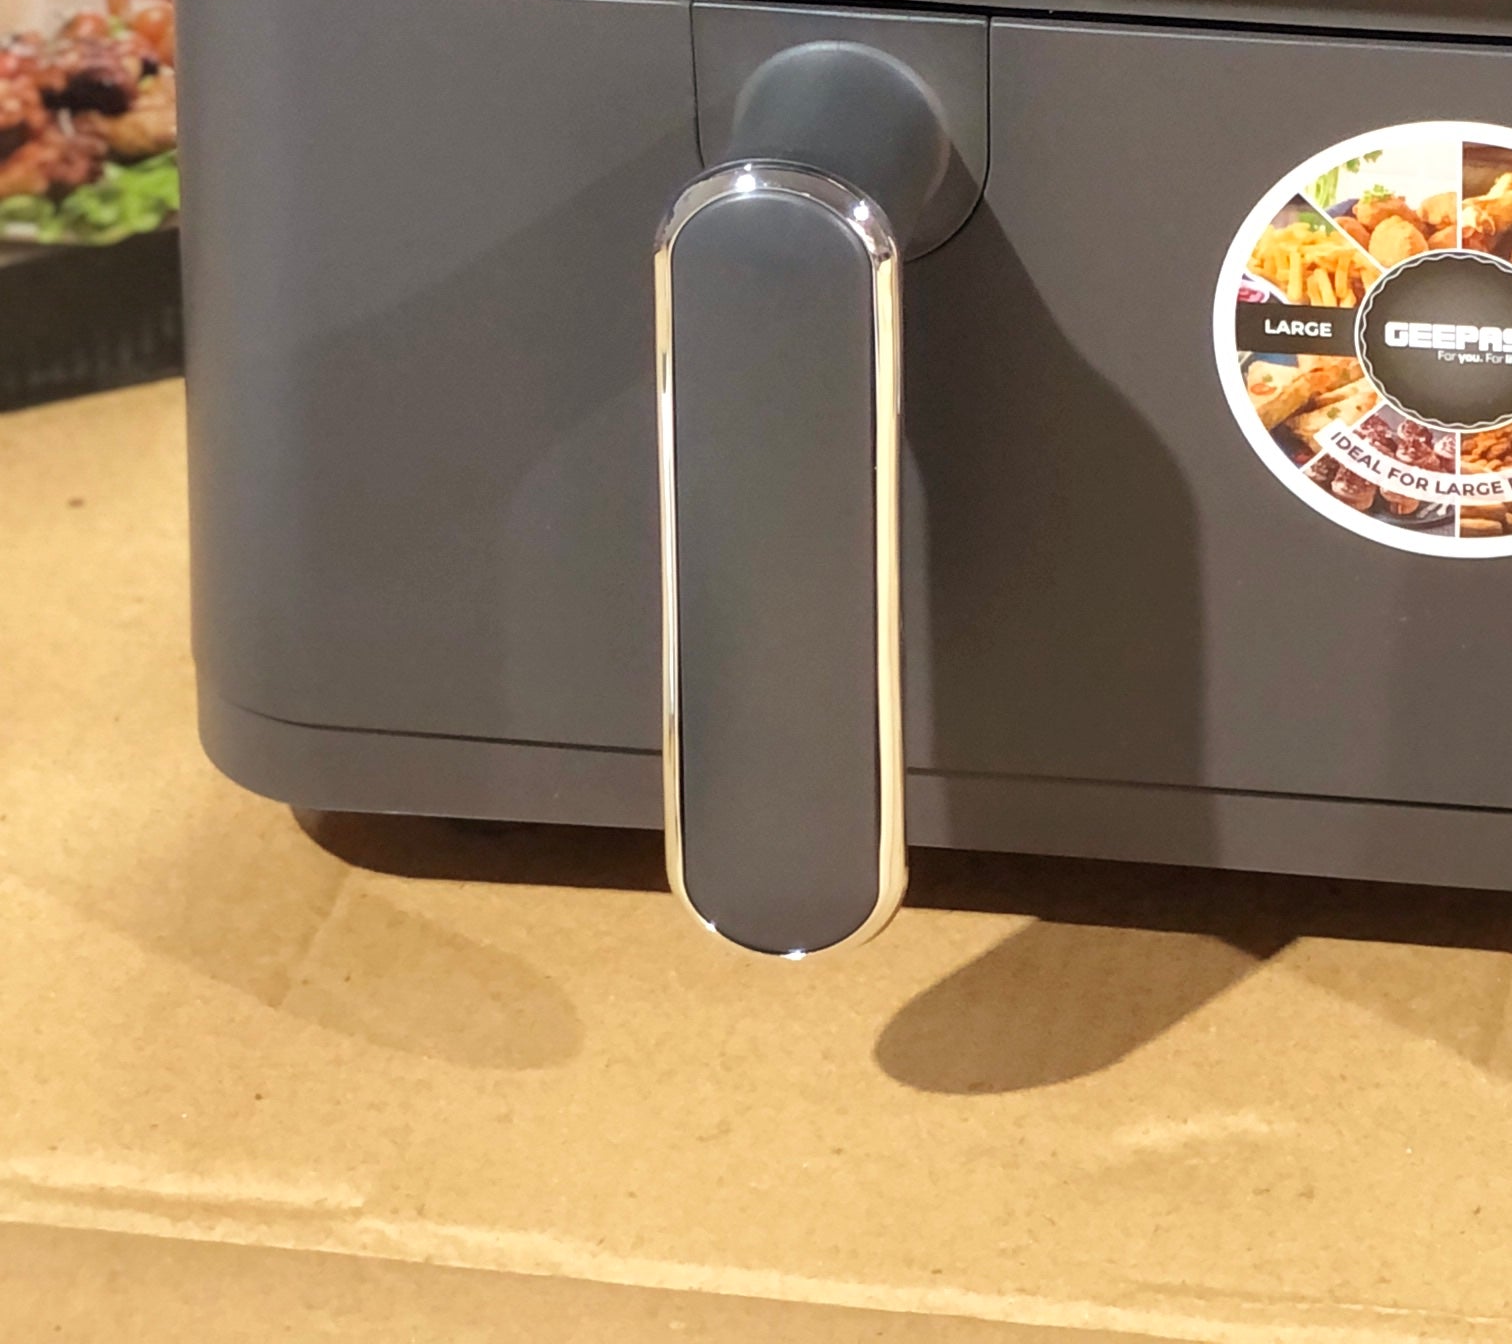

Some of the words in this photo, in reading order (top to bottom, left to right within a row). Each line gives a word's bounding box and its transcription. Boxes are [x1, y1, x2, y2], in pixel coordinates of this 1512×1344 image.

[1265, 319, 1332, 337] LARGE
[1437, 349, 1456, 364] For
[1457, 353, 1484, 366] you.
[1485, 353, 1504, 365] For
[1330, 430, 1384, 476] IDEAL
[1386, 466, 1431, 493] FOR
[1434, 477, 1506, 498] LARGE
